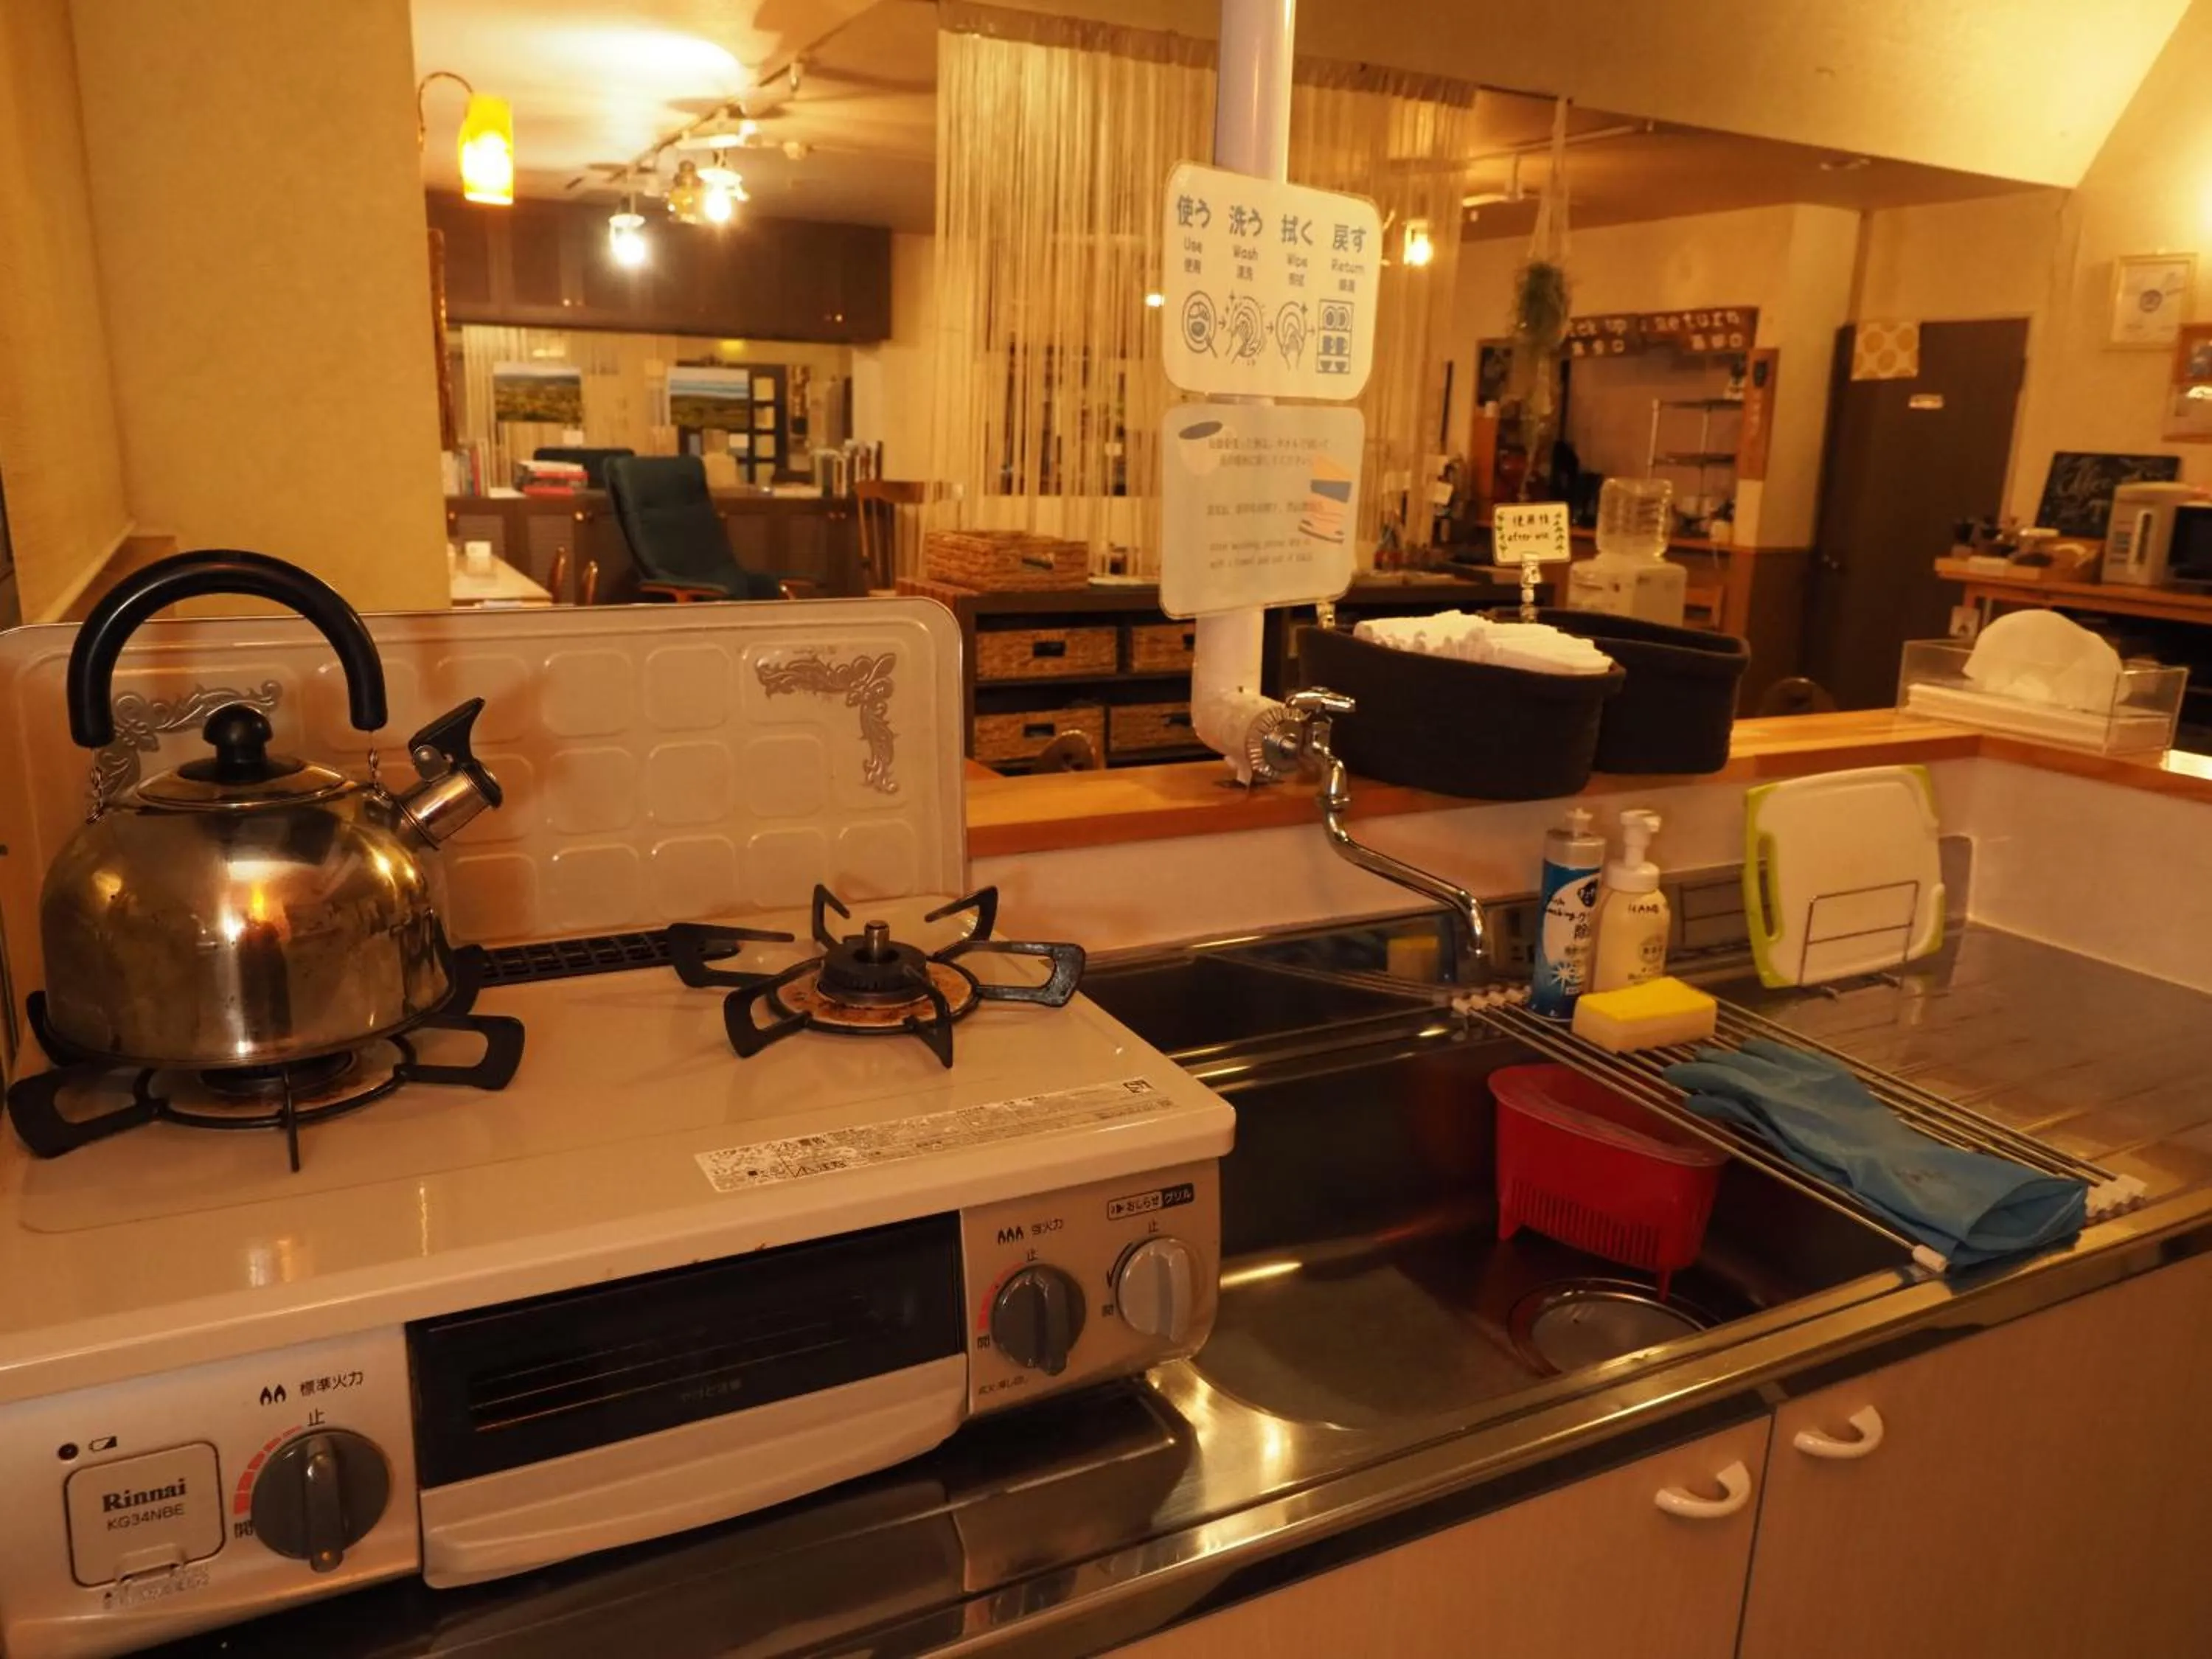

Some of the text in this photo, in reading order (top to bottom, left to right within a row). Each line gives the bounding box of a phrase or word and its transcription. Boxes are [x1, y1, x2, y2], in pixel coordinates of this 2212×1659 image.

[1177, 194, 1367, 253] 使う 洗う 拭く 戻す
[1183, 234, 1365, 275] Use Wash Wipe Return
[1654, 310, 1741, 331] Return
[1126, 1187, 1192, 1212] おしらせ グリル
[1148, 1219, 1160, 1234] 止
[1026, 1248, 1038, 1262] 止
[299, 1371, 364, 1397] 標準火力
[307, 1408, 325, 1427] 止
[102, 1478, 187, 1513] Rinnai
[106, 1503, 186, 1531] KG34NBE
